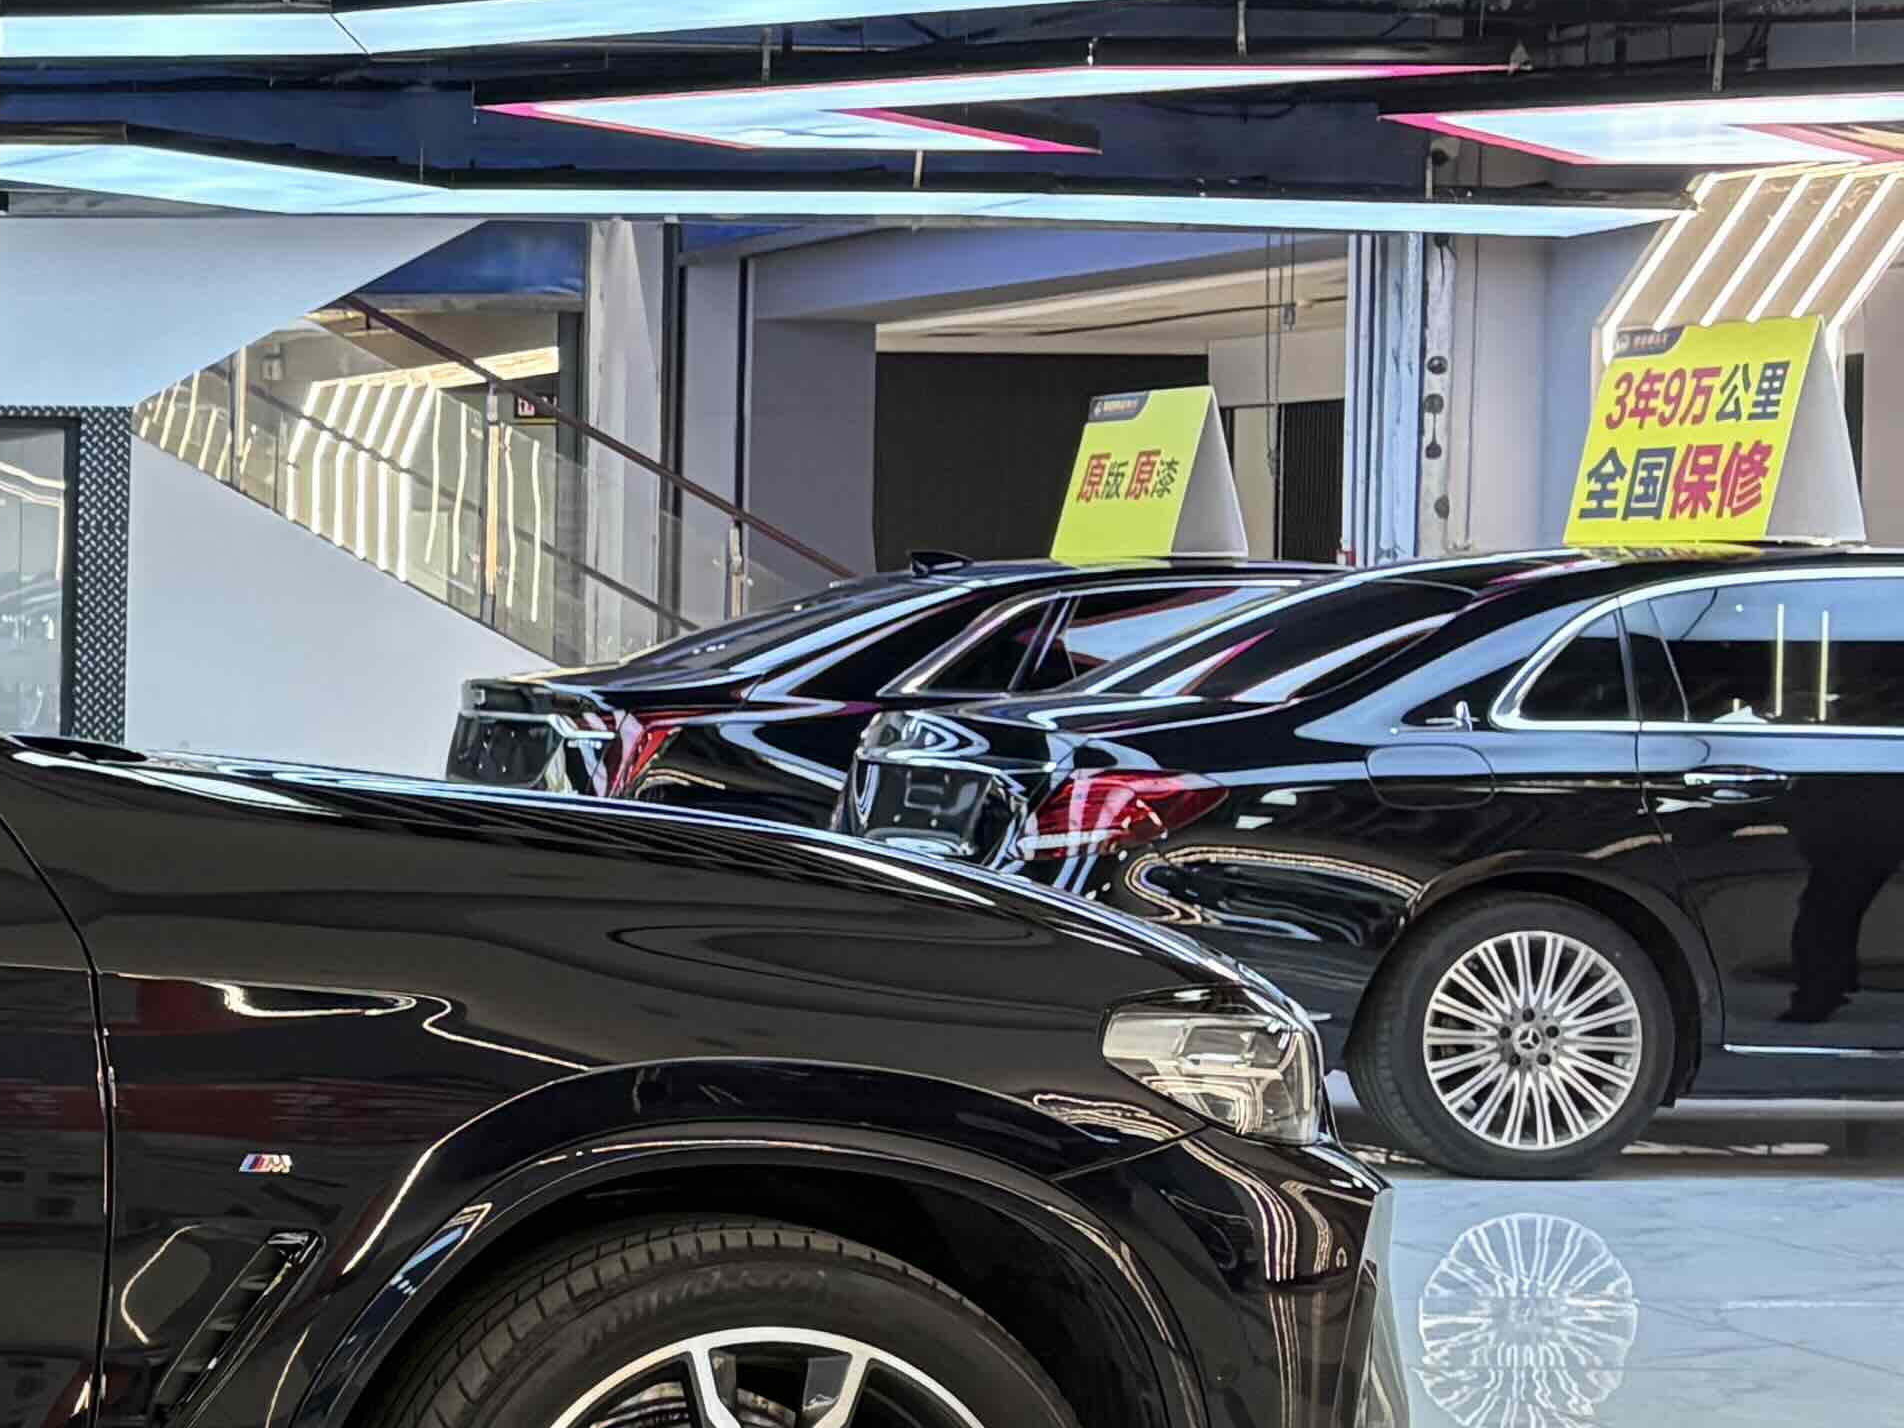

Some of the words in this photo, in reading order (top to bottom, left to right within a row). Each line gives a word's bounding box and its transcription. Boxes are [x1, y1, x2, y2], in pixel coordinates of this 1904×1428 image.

[1604, 360, 1791, 431] 3年9万公里
[1075, 448, 1181, 504] 原版原漆
[1578, 439, 1774, 521] 全国保修
